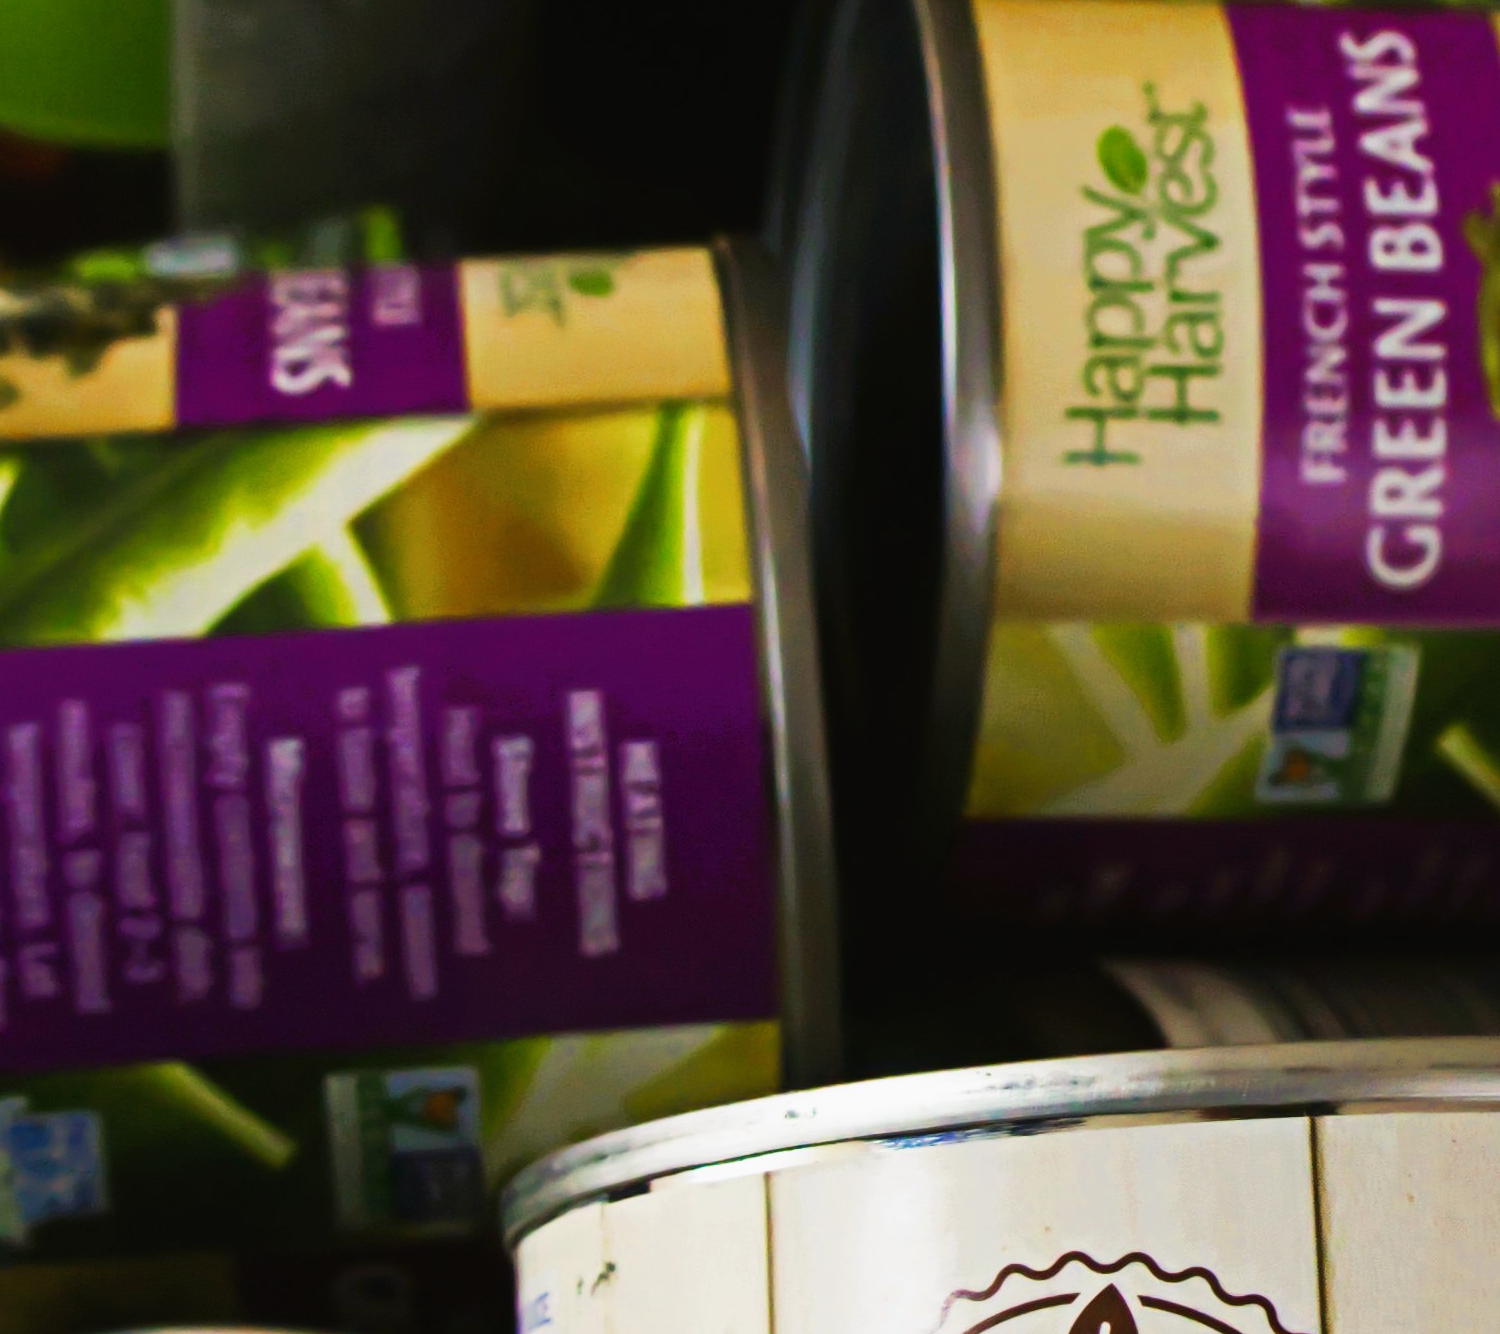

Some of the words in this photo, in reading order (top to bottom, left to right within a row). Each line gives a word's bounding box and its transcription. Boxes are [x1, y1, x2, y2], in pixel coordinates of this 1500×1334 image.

[1141, 100, 1224, 430] Harvest
[1286, 105, 1344, 252] STYLE
[1340, 27, 1448, 275] BEANS
[1062, 186, 1156, 467] Happy
[1300, 256, 1350, 485] FRENCH
[1365, 297, 1449, 589] GREEN
